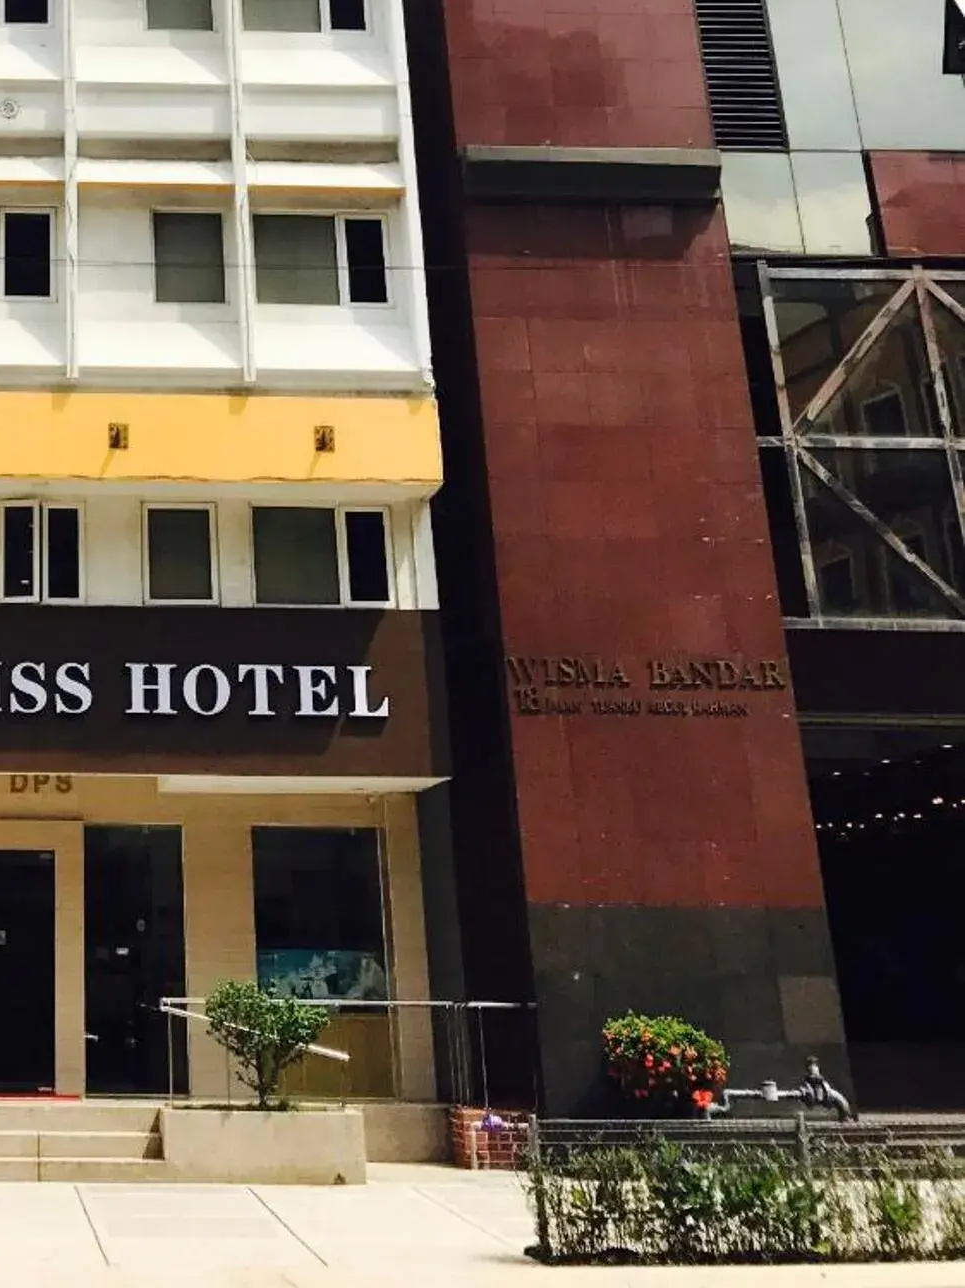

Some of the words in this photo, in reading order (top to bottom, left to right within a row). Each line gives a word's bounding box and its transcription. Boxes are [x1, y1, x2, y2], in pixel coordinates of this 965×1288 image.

[125, 661, 390, 717] HOTEL
[507, 656, 630, 688] WISMA
[647, 660, 786, 691] BANDAR
[9, 774, 74, 794] DPS
